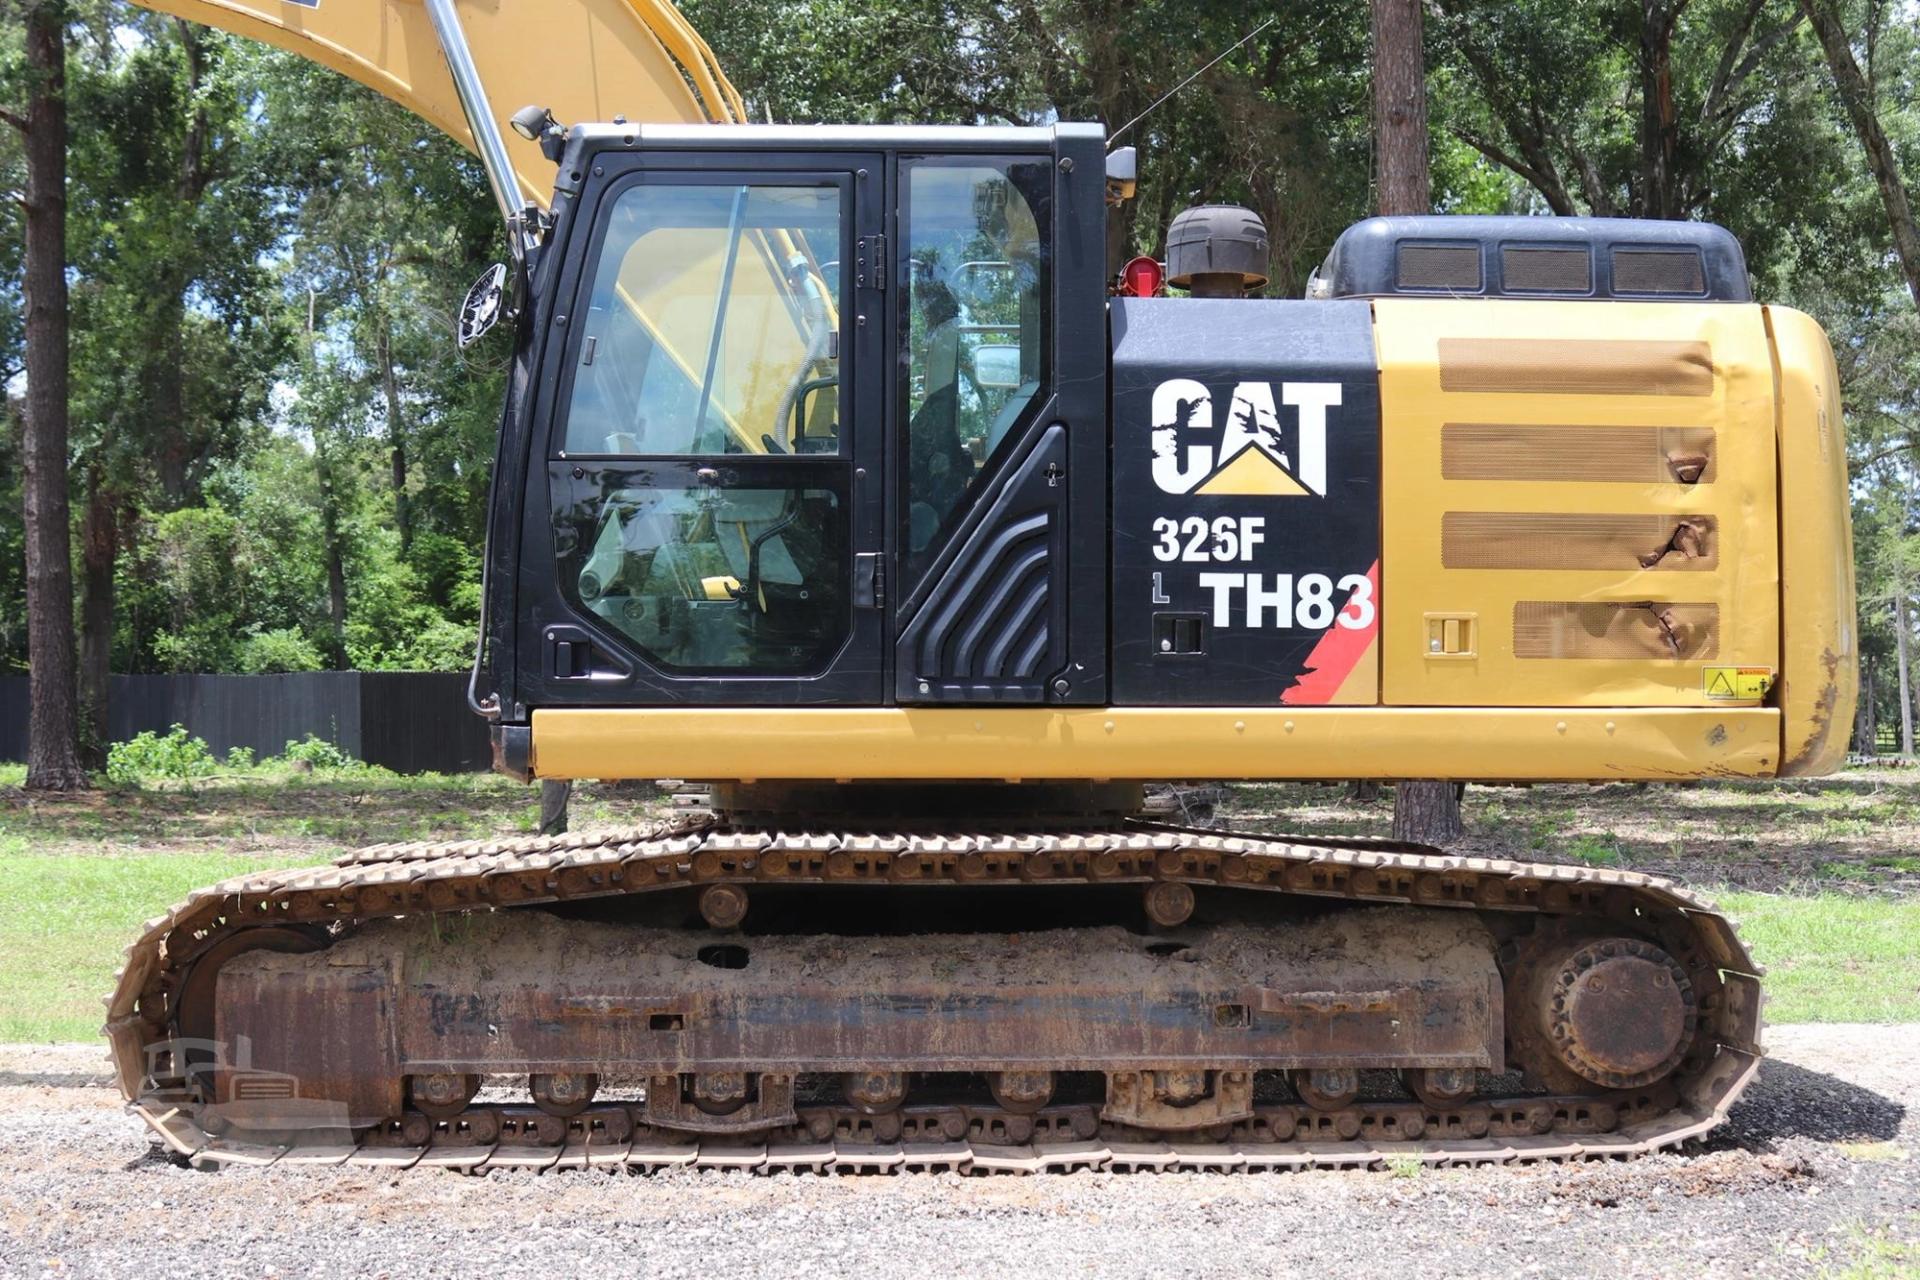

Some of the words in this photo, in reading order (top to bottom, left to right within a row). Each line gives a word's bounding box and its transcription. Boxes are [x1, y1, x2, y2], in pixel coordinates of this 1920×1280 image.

[1152, 379, 1342, 497] CAT
[1152, 516, 1265, 562] 326F
[1152, 572, 1170, 603] L
[1199, 573, 1375, 630] TH83
